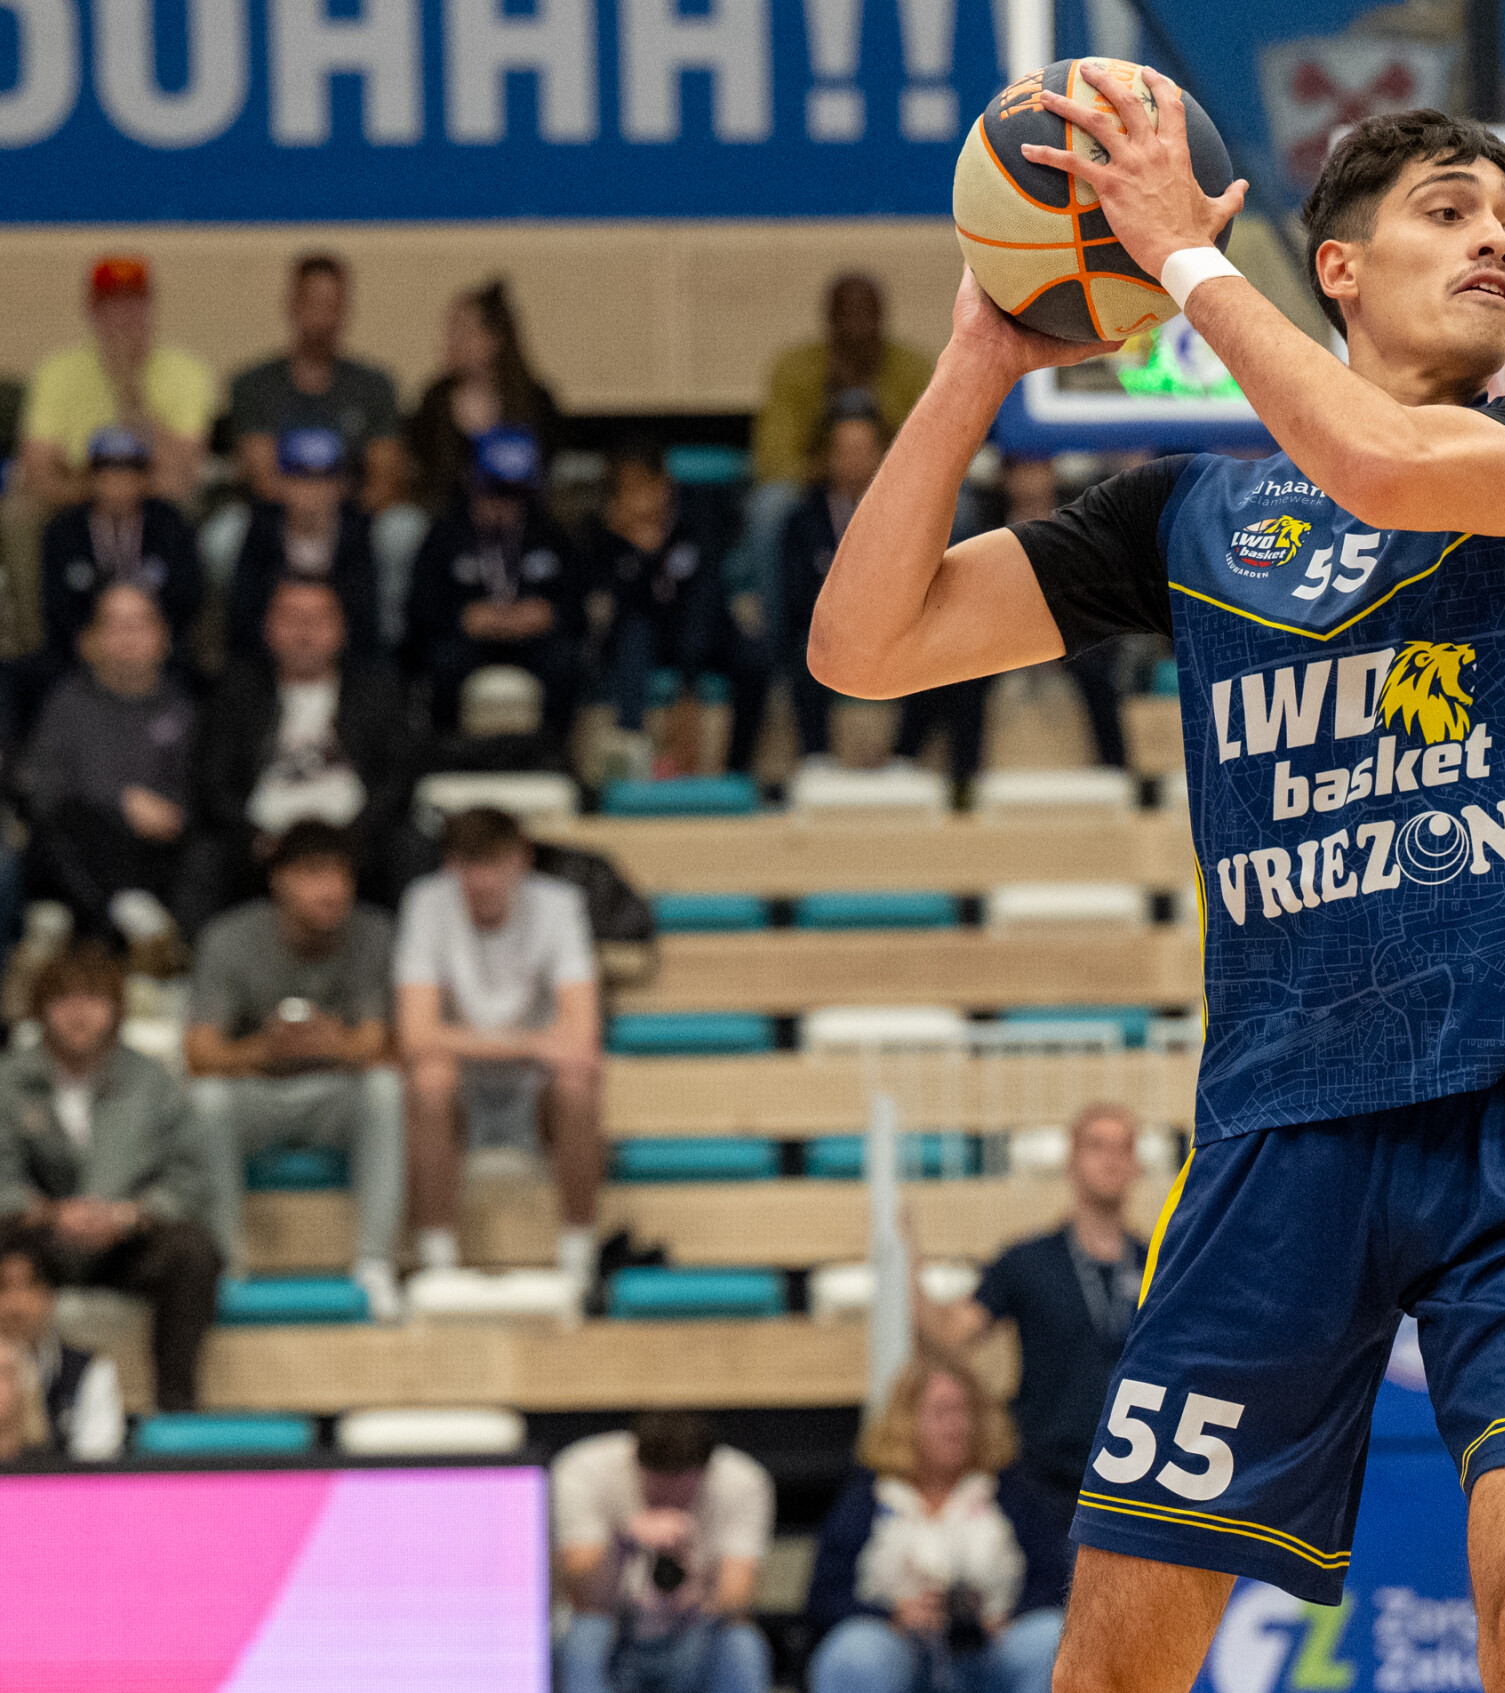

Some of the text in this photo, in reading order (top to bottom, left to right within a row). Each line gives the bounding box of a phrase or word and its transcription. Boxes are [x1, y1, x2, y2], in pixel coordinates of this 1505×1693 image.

[1225, 552, 1269, 579] LEEUWARDEN
[1239, 547, 1287, 561] basket
[1291, 532, 1381, 600] 55
[1272, 723, 1494, 822] basket
[1092, 1377, 1246, 1501] 55
